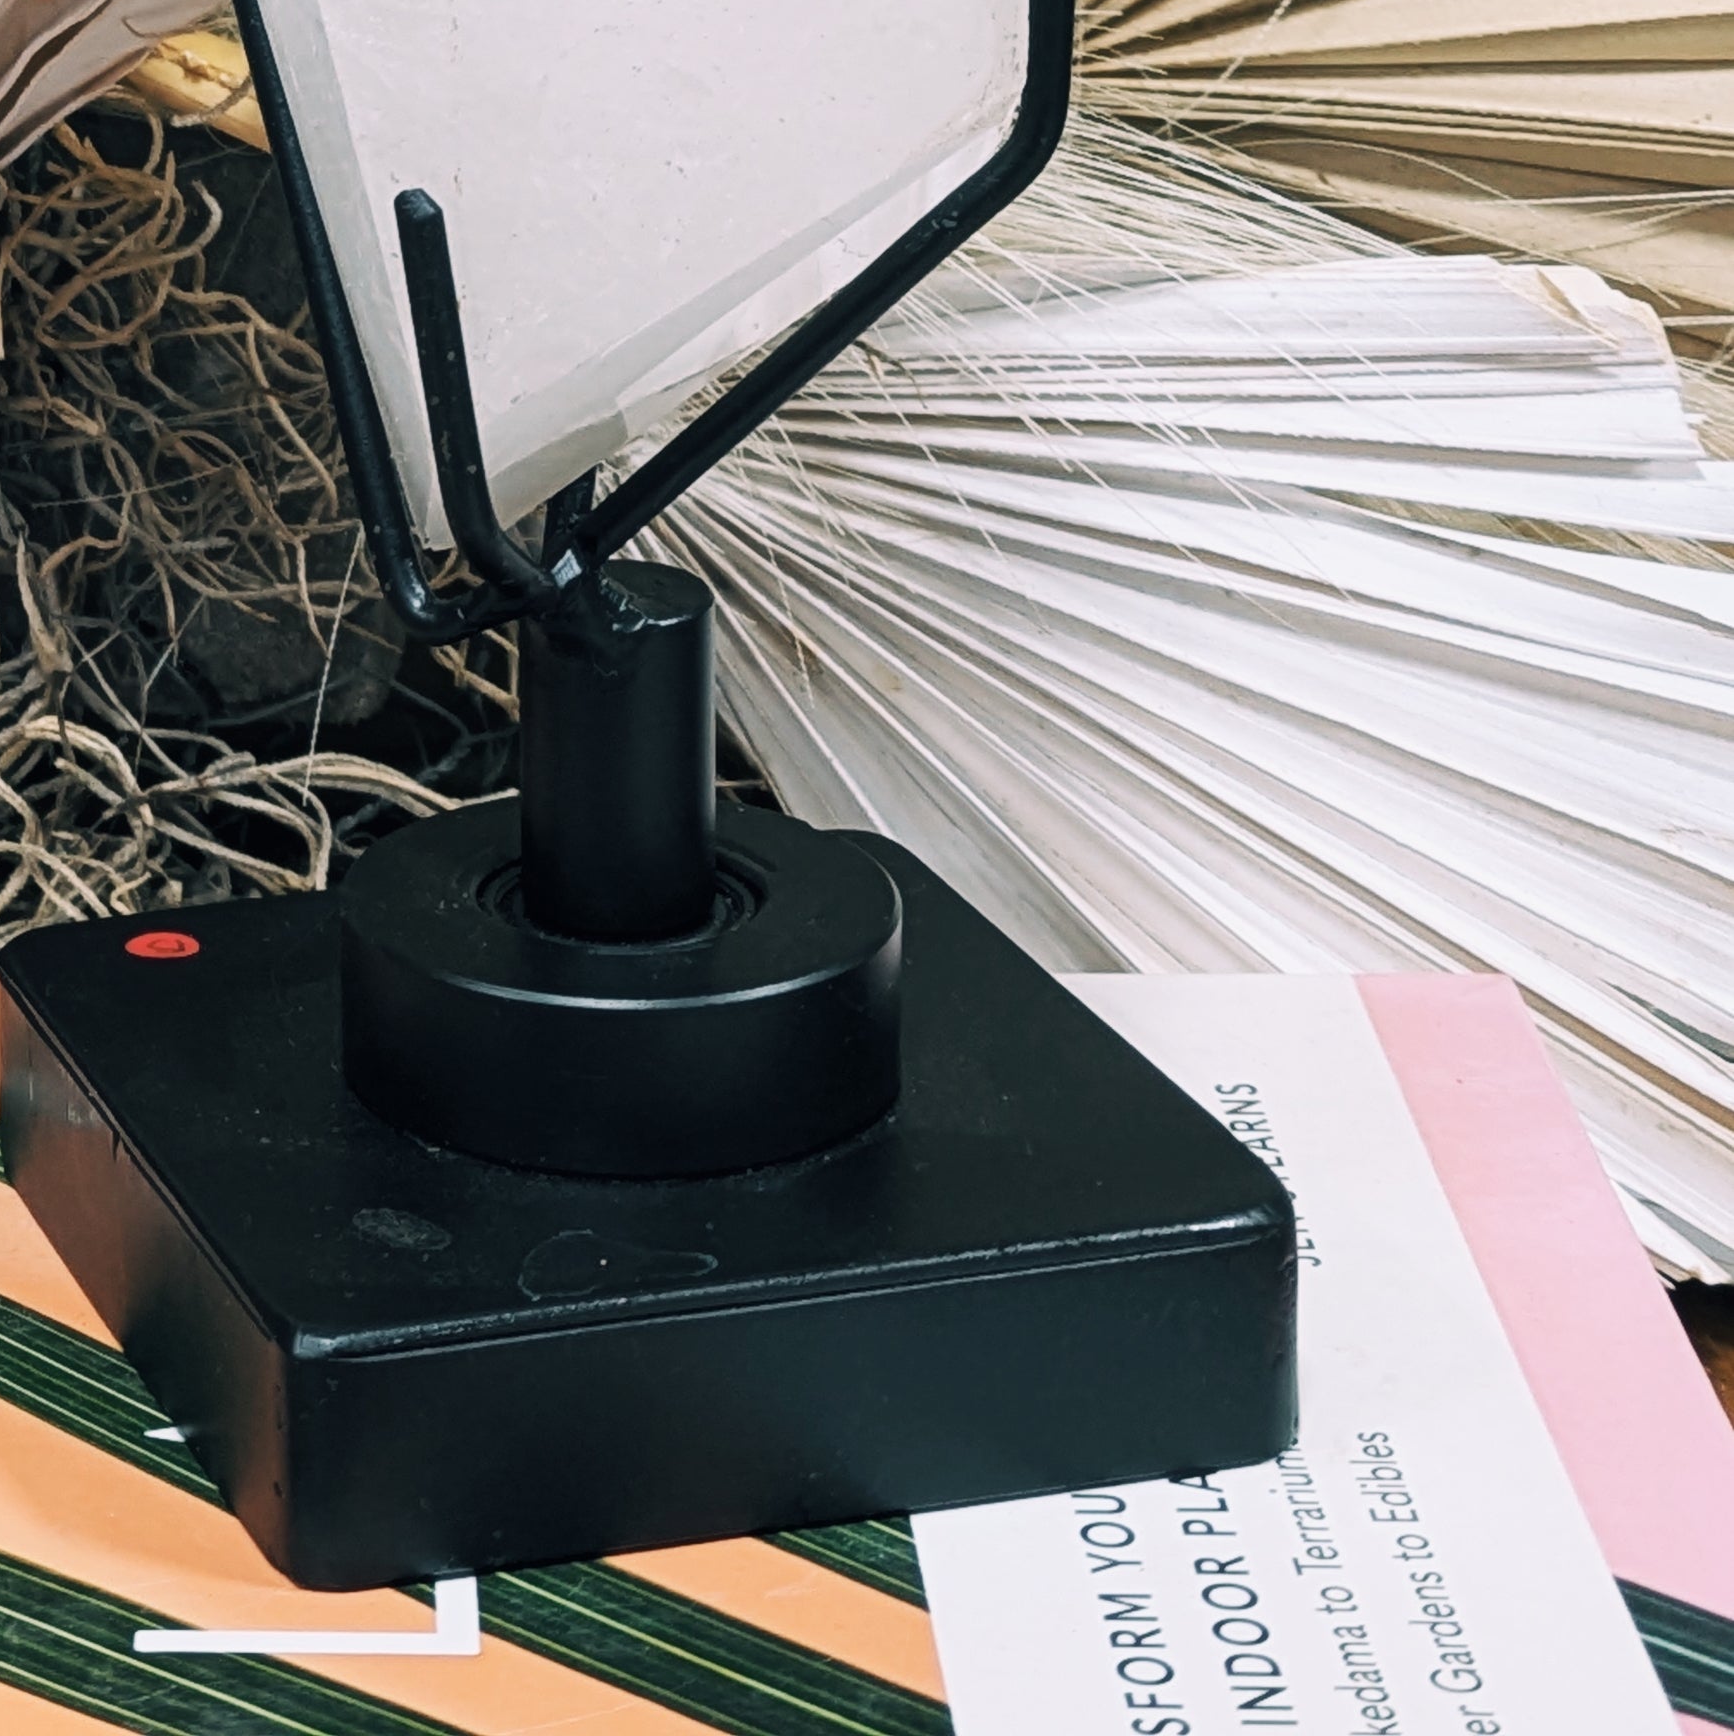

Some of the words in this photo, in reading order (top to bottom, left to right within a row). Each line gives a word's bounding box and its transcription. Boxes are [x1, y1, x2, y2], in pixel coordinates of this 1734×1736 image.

[1269, 1440, 1343, 1576] Terrarium
[1349, 1431, 1420, 1523] Edibles
[1316, 1584, 1359, 1614] to
[1392, 1533, 1434, 1562] to
[1097, 1593, 1191, 1736] SFORM
[1193, 1555, 1299, 1726] INDOOR
[1332, 1623, 1402, 1736] kedama
[1408, 1569, 1483, 1694] Gardens
